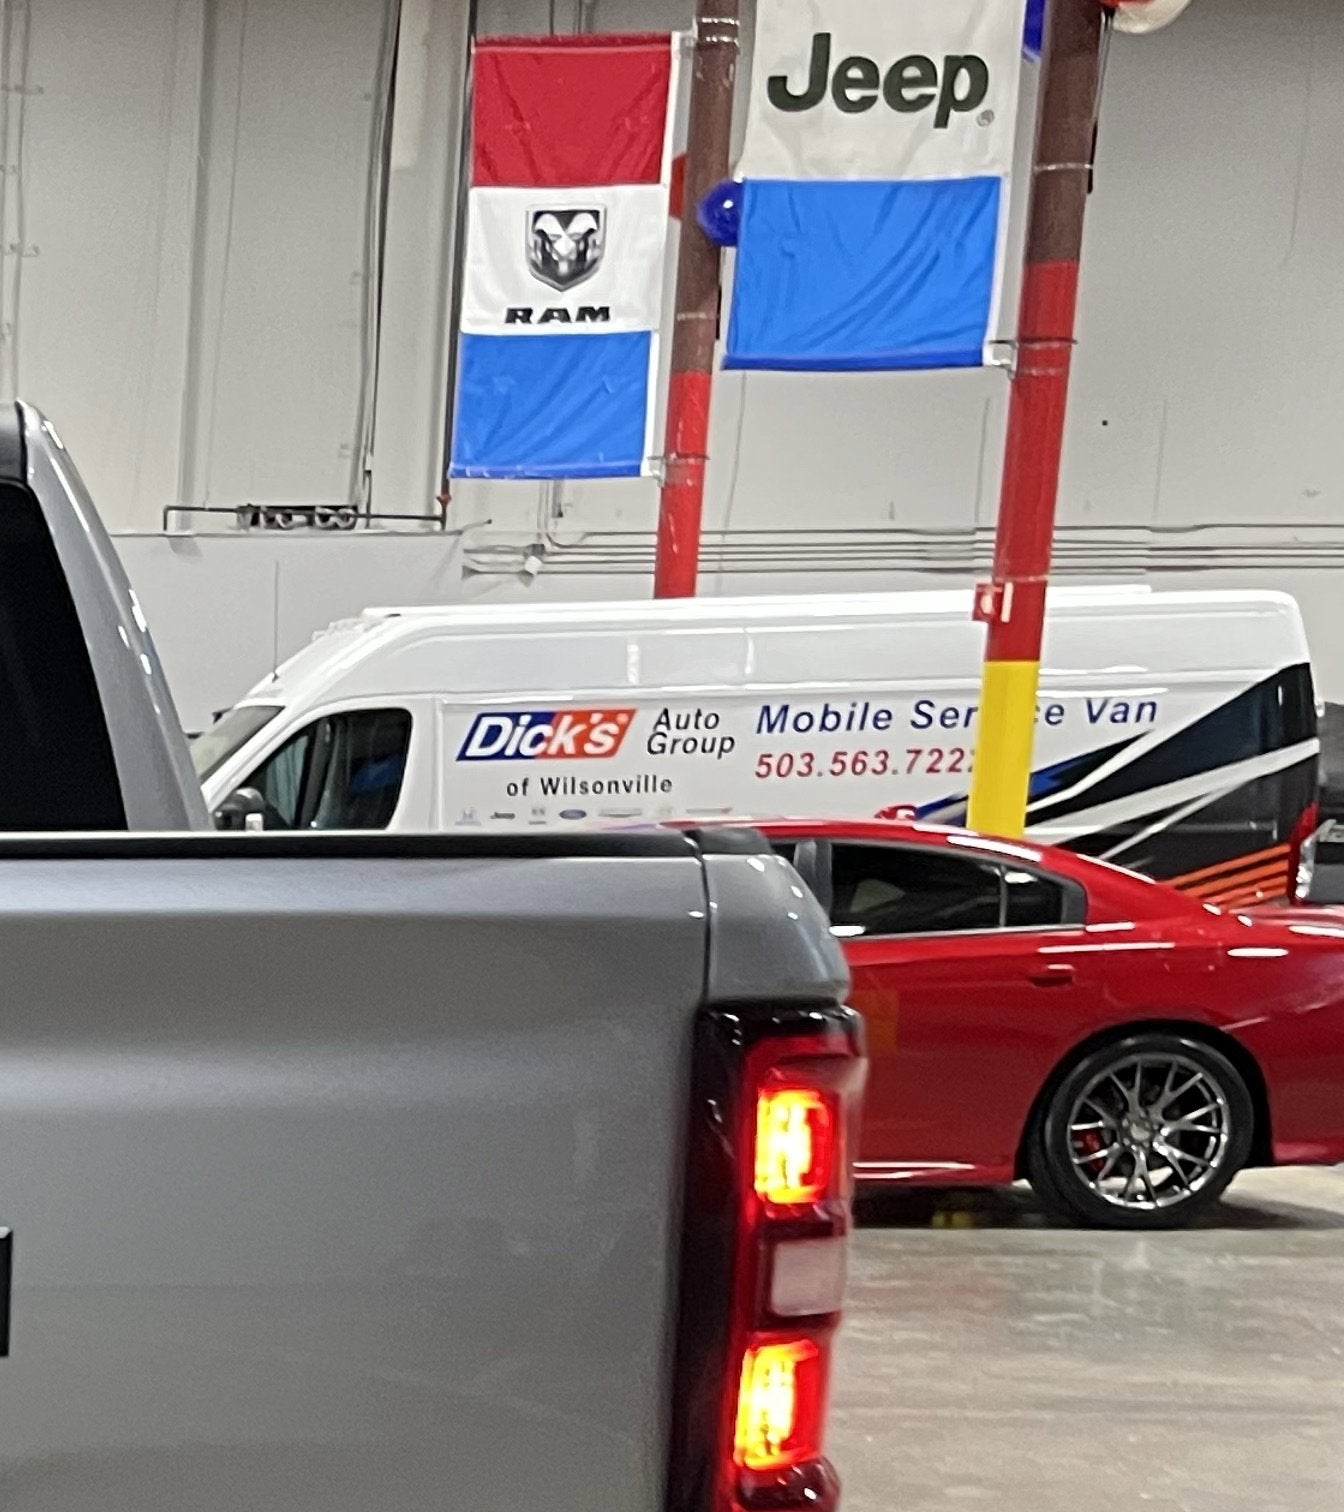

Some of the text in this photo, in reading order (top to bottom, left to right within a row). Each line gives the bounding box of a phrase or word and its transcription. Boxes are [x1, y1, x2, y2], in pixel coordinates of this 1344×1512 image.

[767, 33, 989, 128] Jeep
[505, 305, 611, 325] RAM
[464, 707, 720, 757] Dick's Auto
[755, 696, 1157, 735] Mobile Sere Van
[647, 731, 736, 760] Group
[507, 774, 673, 797] of Wilsonville
